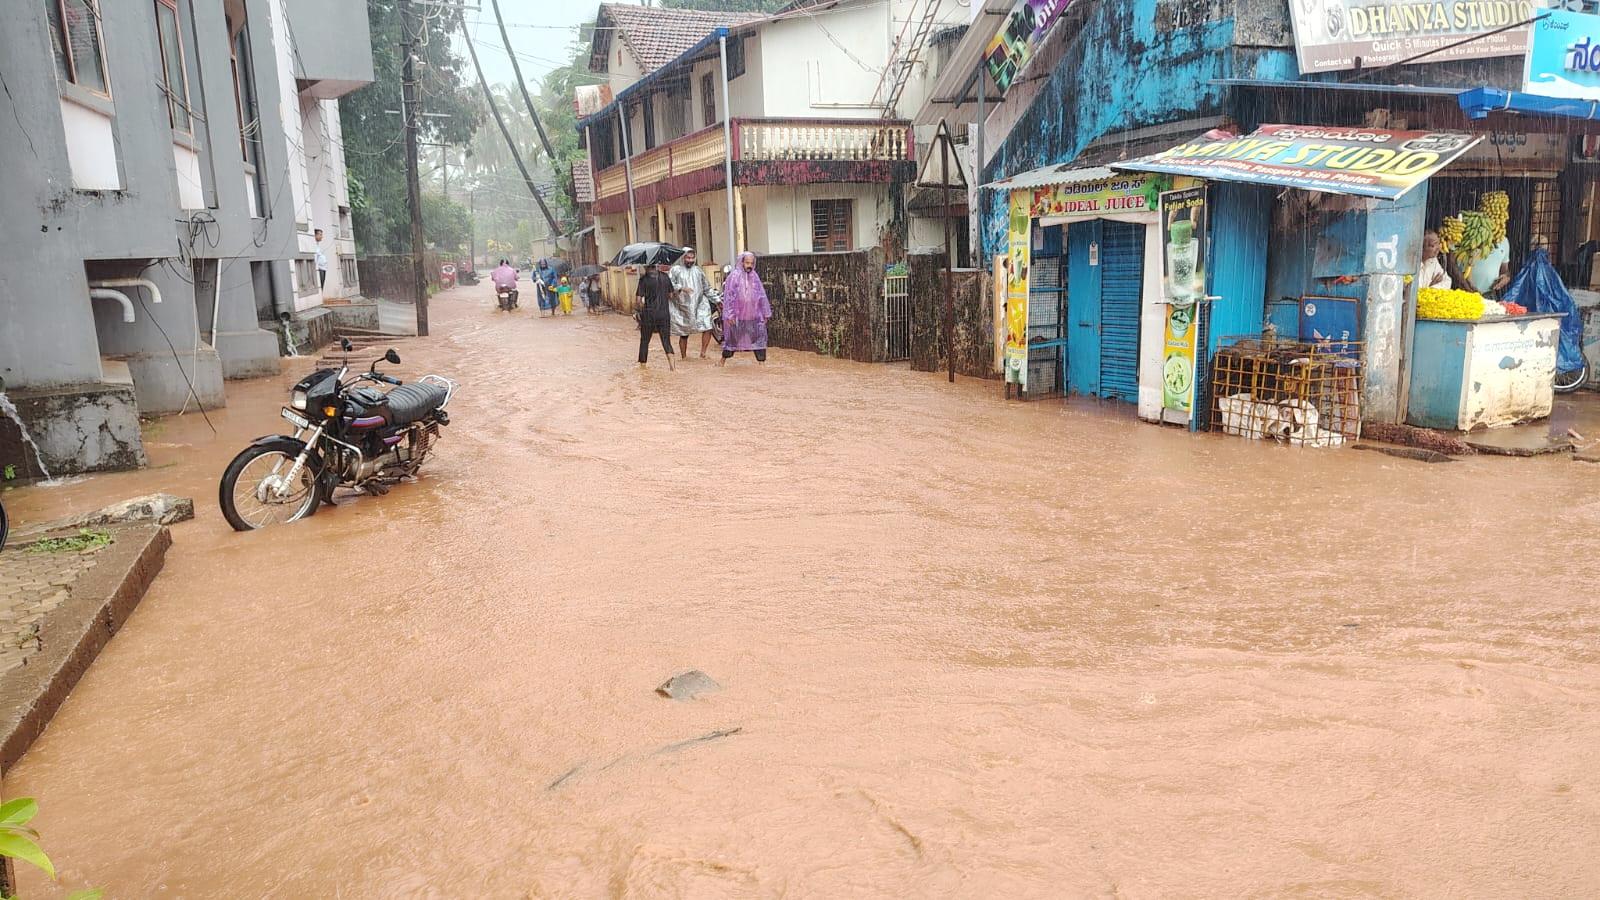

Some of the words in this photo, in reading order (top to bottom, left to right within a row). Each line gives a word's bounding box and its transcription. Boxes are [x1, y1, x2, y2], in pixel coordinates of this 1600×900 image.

[1038, 0, 1058, 28] DH
[1350, 2, 1451, 36] DHANYA
[1453, 0, 1532, 30] STUDIO
[1372, 40, 1402, 53] Quick
[1404, 38, 1412, 49] 5
[1412, 37, 1440, 49] Minutes
[1314, 57, 1343, 67] Contact
[1283, 143, 1440, 175] STUDIO
[1305, 169, 1331, 181] Size
[1330, 173, 1374, 185] Photos
[1064, 199, 1100, 213] IDEAL
[1105, 195, 1145, 210] JUICE
[1185, 198, 1204, 208] Soda
